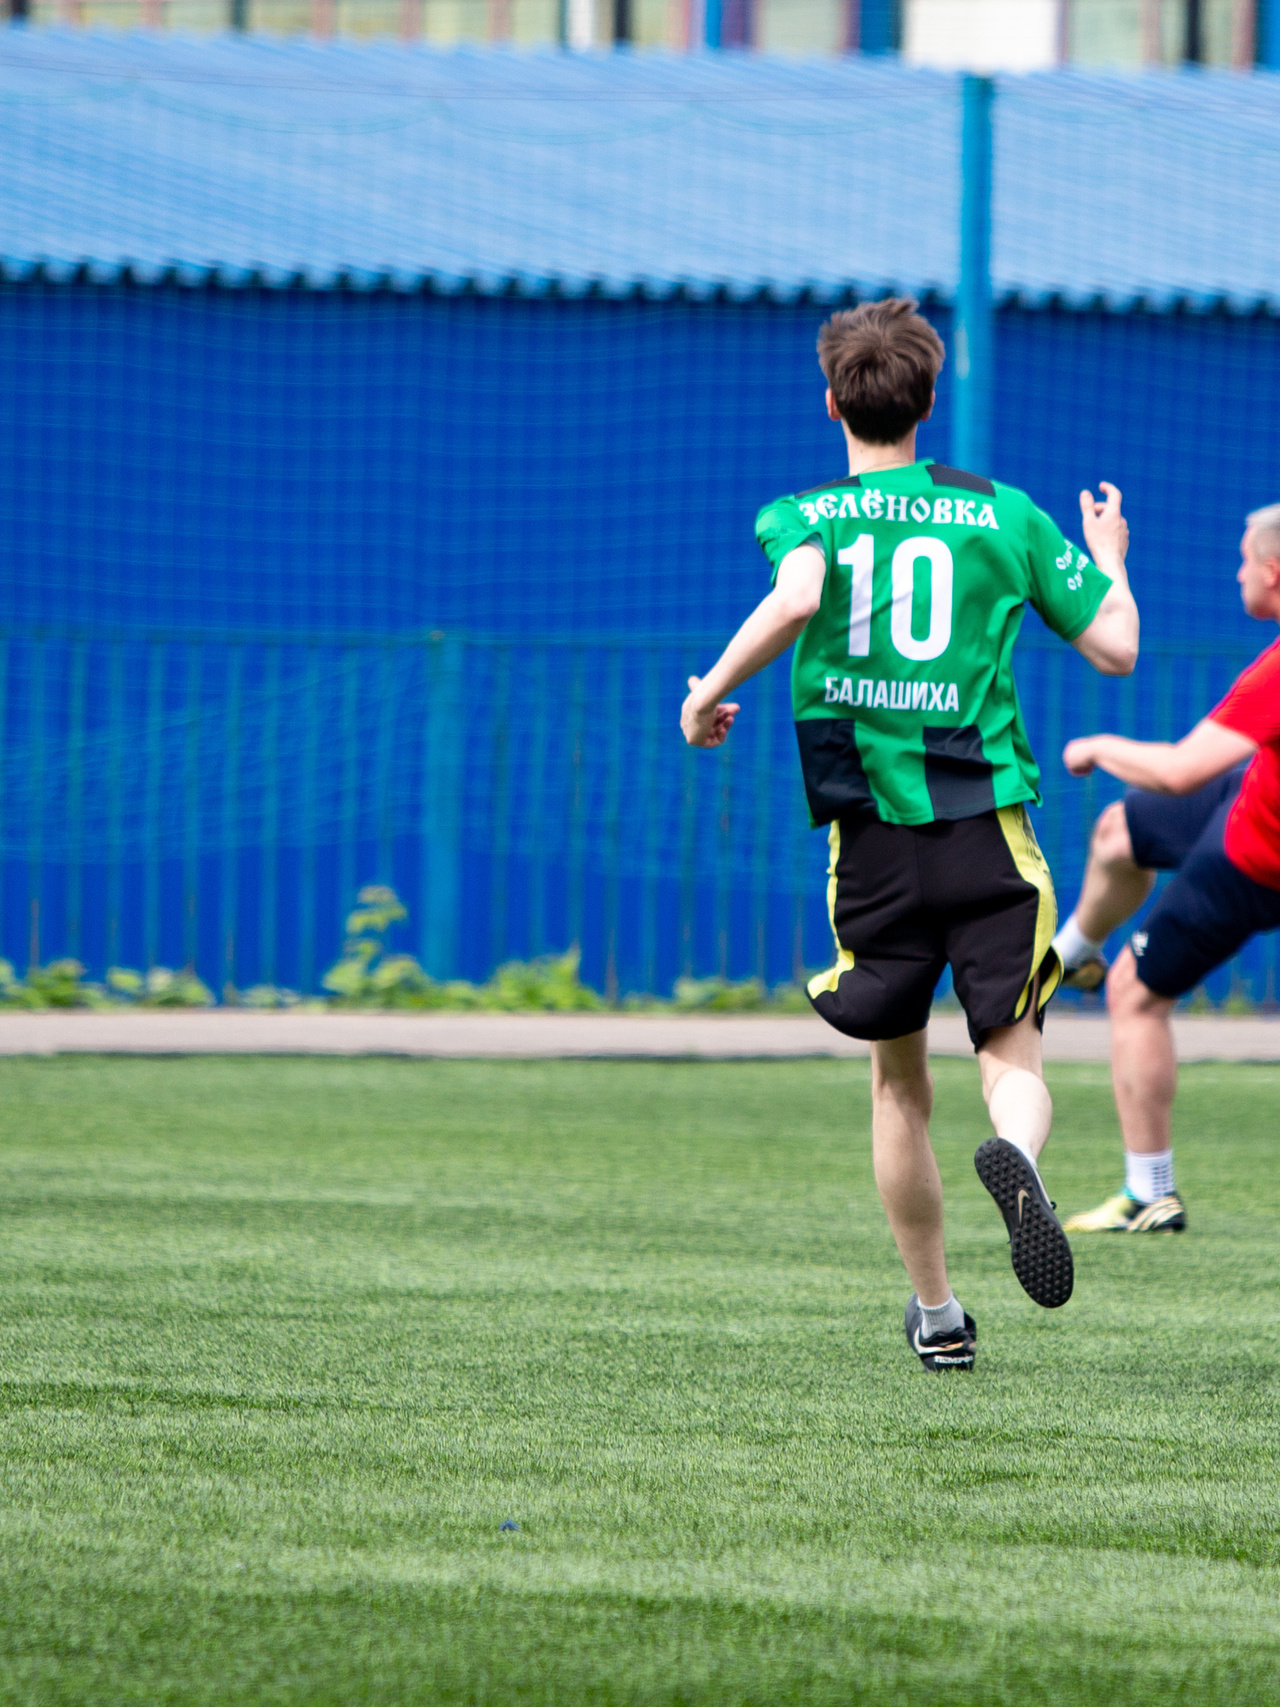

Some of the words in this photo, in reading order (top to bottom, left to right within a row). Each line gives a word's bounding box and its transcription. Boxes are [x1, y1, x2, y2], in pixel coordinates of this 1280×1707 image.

[798, 488, 1000, 530] ЗЕЛЁНОВКА
[836, 533, 954, 662] 10
[824, 676, 960, 712] БАЛАШИХА
